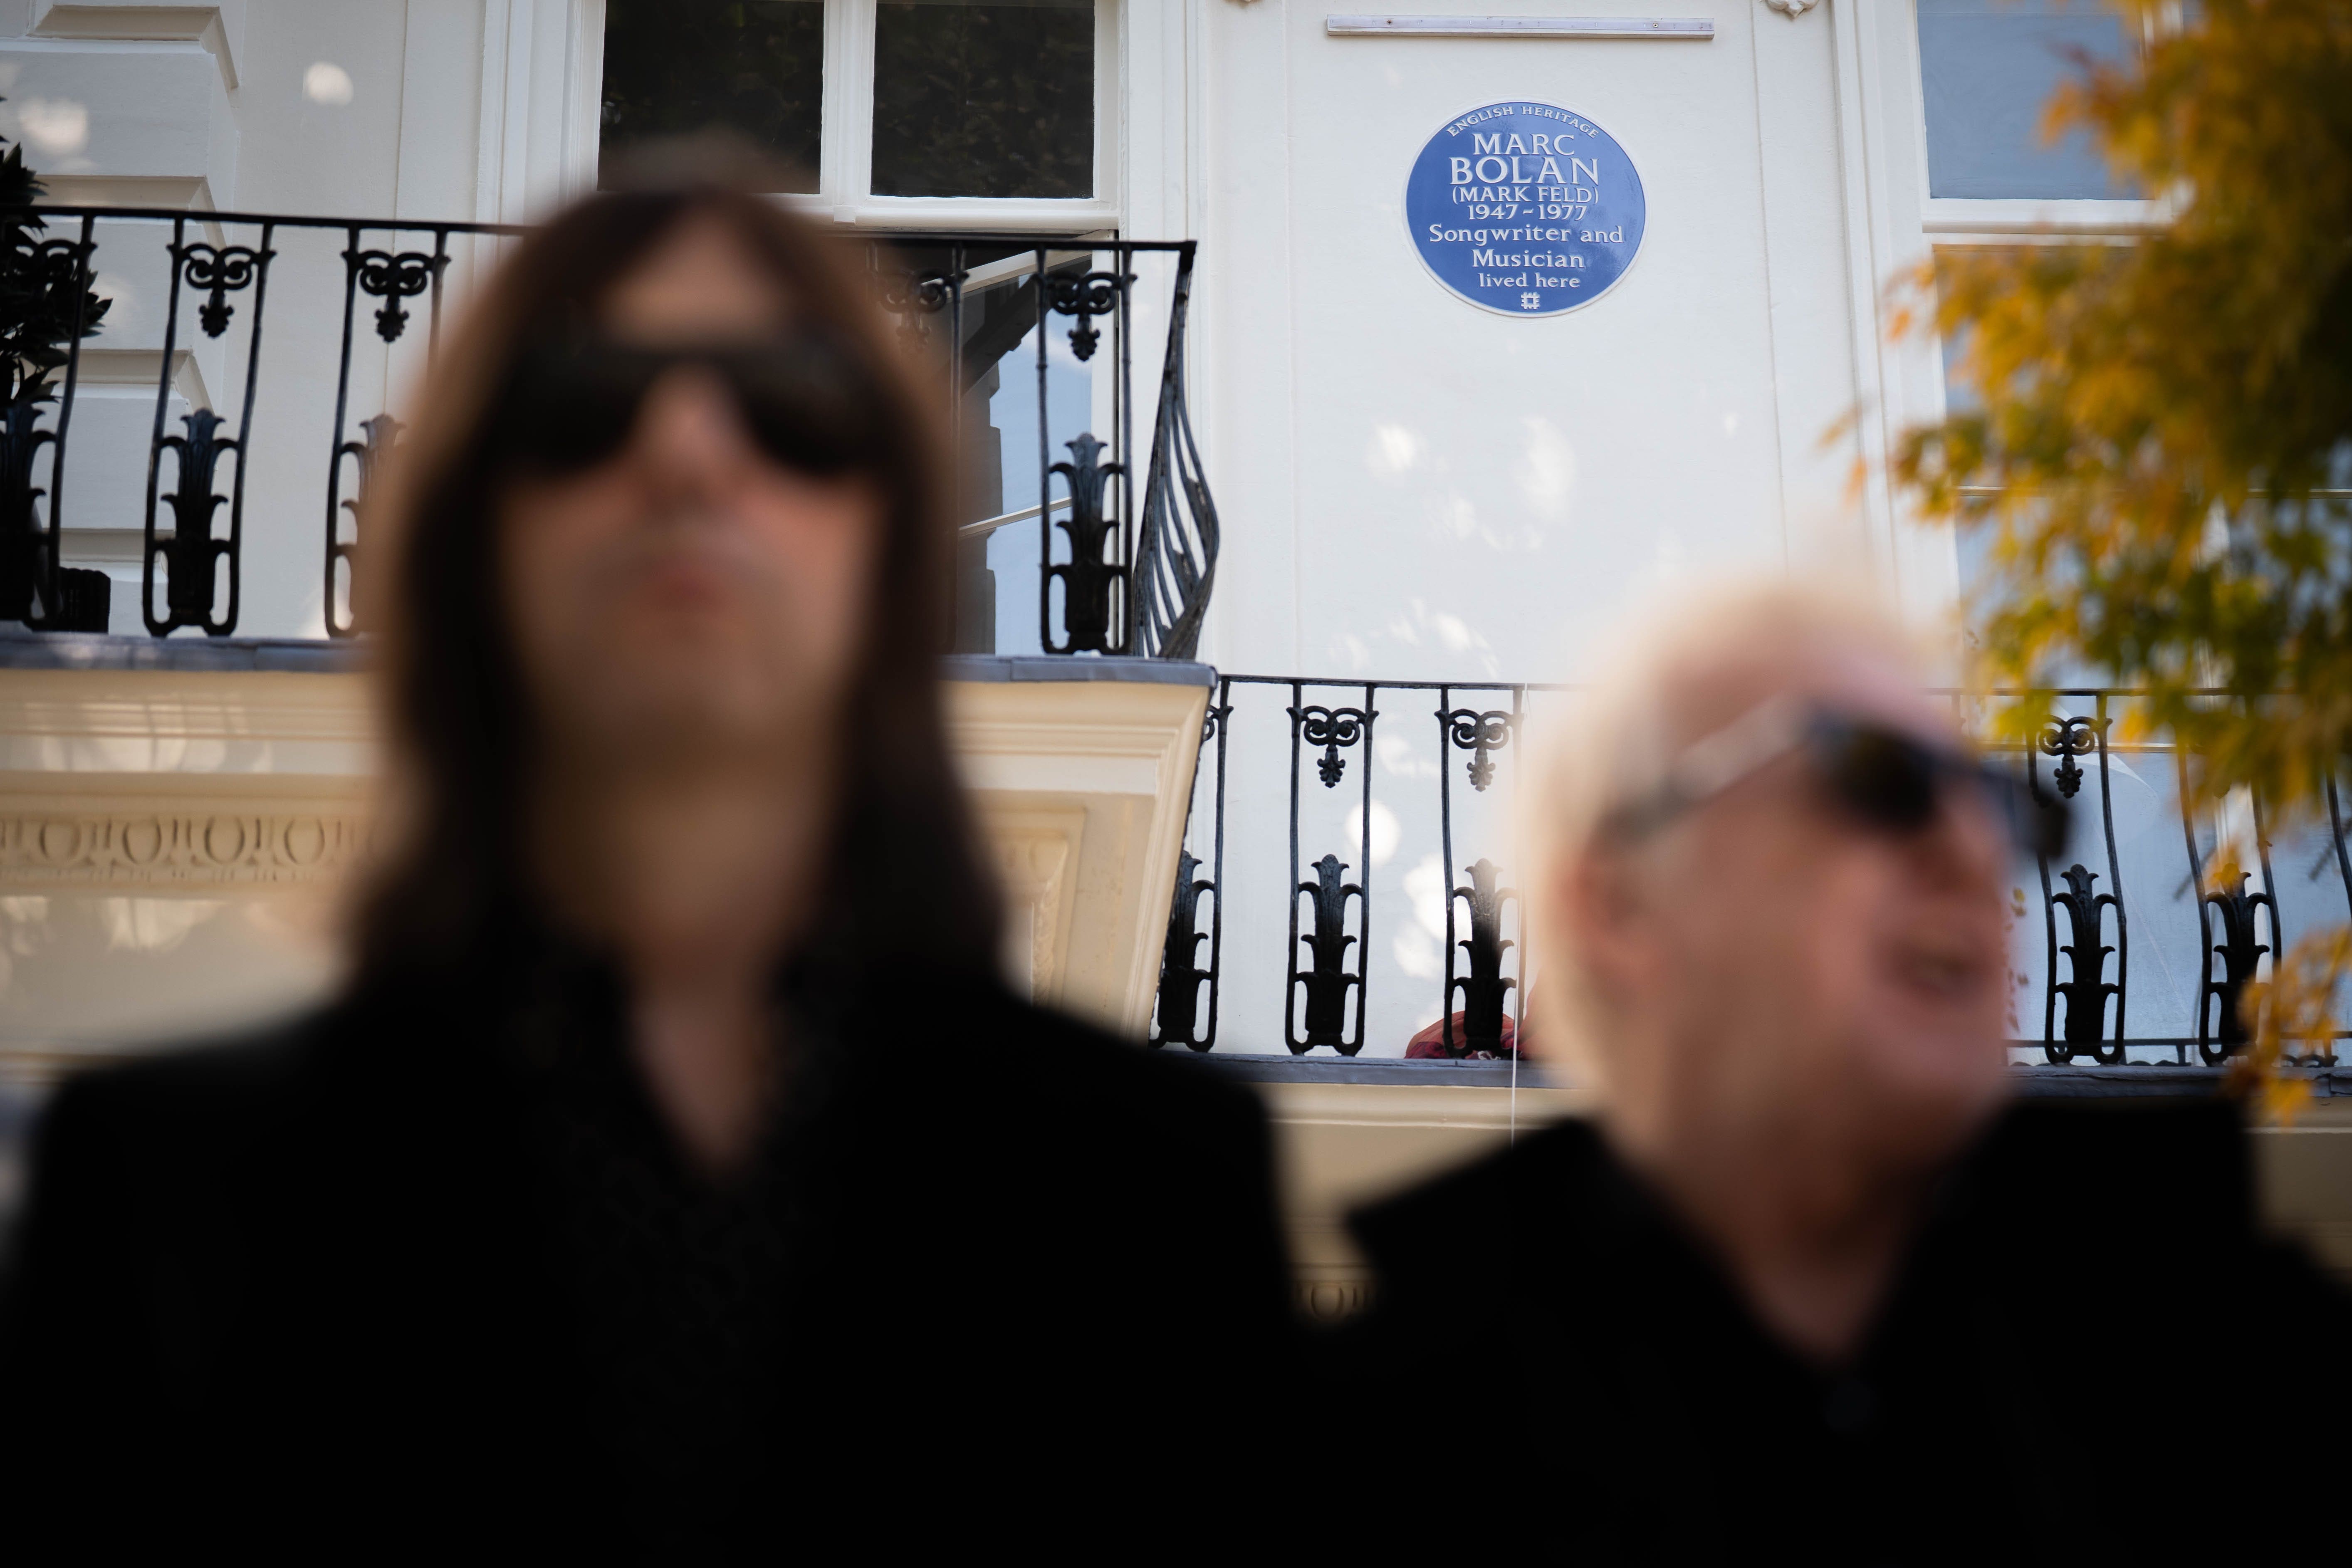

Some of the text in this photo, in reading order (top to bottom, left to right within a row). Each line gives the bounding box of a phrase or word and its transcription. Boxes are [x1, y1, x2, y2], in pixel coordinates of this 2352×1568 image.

[1445, 106, 1599, 138] ENGLISH HERITAGE
[1472, 133, 1575, 156] MARC
[1449, 156, 1599, 185] BOLAN
[1452, 186, 1600, 204] (MARK FELD)
[1429, 223, 1625, 246] Songwriter and
[1472, 249, 1585, 268] Musician
[1479, 272, 1580, 288] lived here
